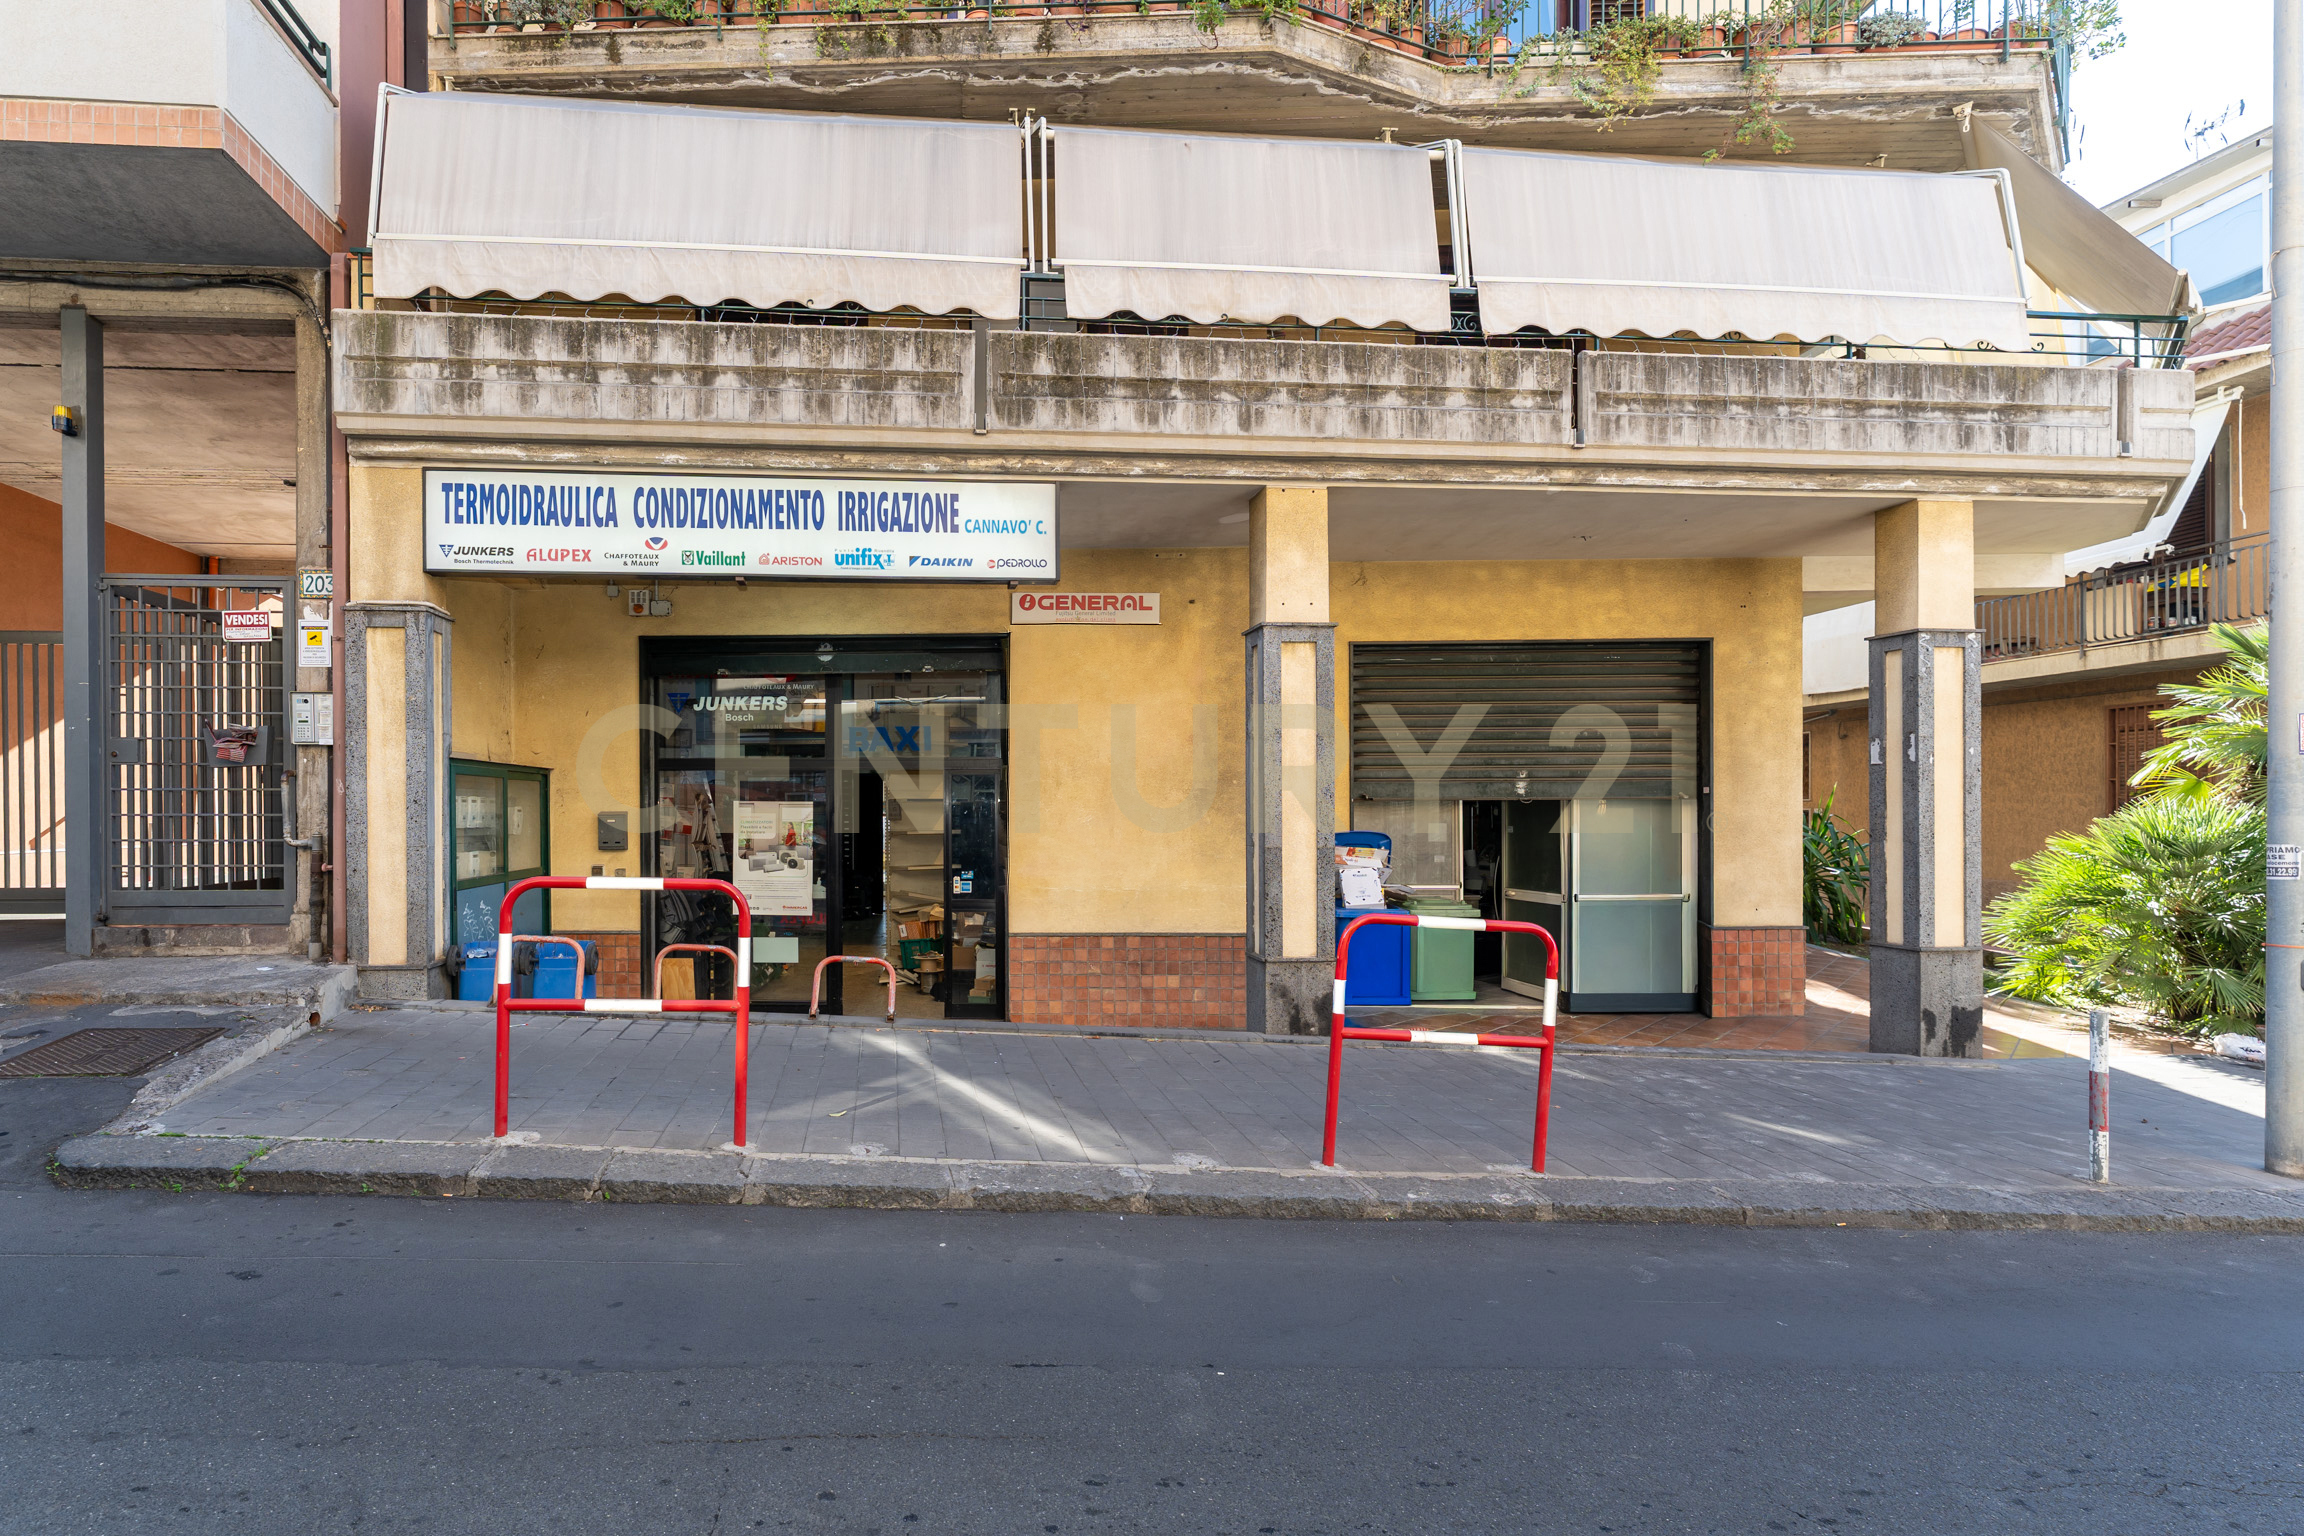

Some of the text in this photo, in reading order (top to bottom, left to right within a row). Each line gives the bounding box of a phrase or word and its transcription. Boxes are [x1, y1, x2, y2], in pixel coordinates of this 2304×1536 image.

[441, 482, 1047, 535] TERMOIDRAULICA CONDIZIONAMENTO IRRIGAZIONE CANNAVO' C.
[453, 546, 514, 557] JUNKERS
[526, 548, 592, 562] ALUPEX
[604, 552, 660, 560] CHAFFOTEAUX
[695, 550, 746, 567] Vaillant
[834, 547, 886, 570] unifix
[771, 556, 823, 566] ARISTON
[921, 557, 973, 567] DAIKIN
[996, 557, 1048, 569] PEDROLLO
[305, 575, 333, 593] 203
[1037, 595, 1153, 611] GENERAL
[225, 614, 268, 626] VENDESI
[692, 695, 789, 712] JUNKERS
[725, 713, 754, 722] Bosch
[847, 725, 932, 752] BAXI
